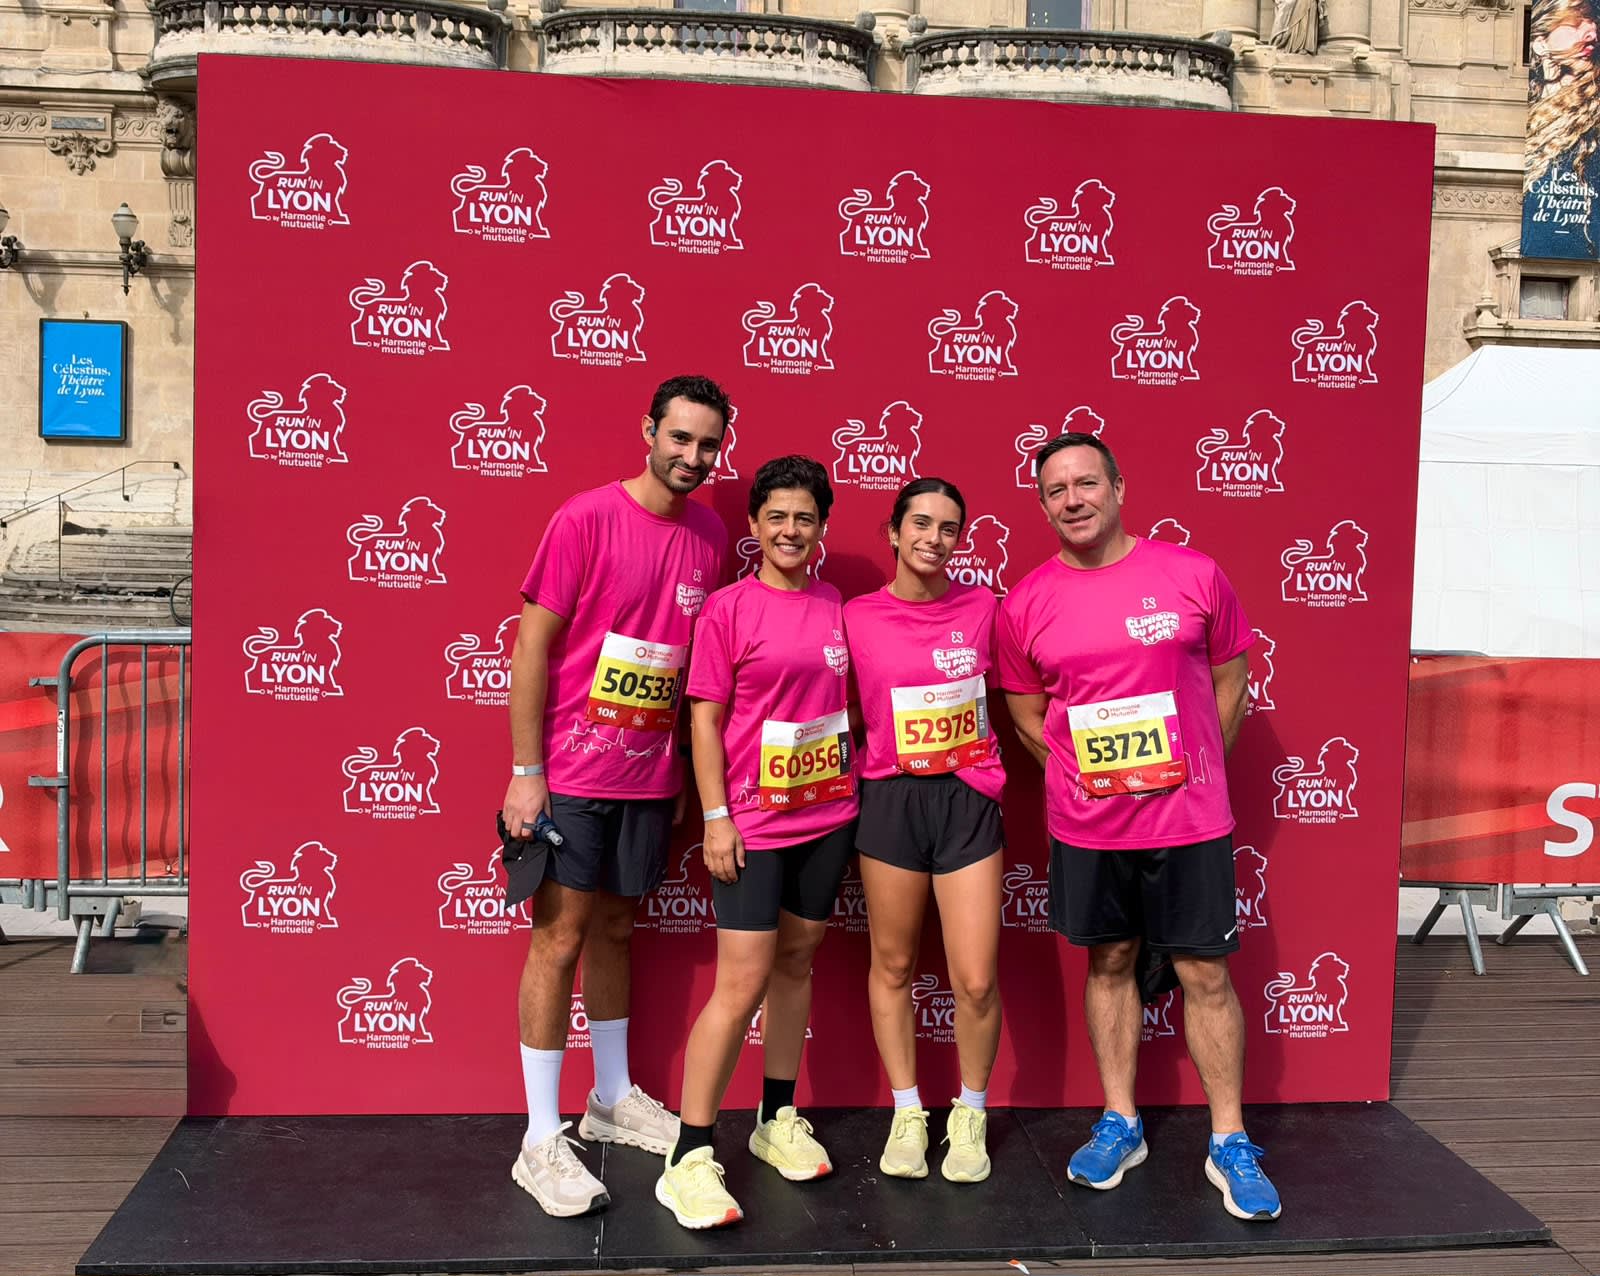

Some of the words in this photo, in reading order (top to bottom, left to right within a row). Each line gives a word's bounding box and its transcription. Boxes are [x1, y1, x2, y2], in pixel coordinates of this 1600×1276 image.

[1553, 168, 1577, 182] Les
[1529, 180, 1598, 198] Célestins,
[268, 189, 331, 212] LYON
[280, 211, 326, 221] Harmonie
[469, 202, 532, 226] LYON
[1533, 208, 1551, 222] de
[1553, 208, 1591, 225] Lyon.
[281, 220, 324, 229] mutuelle
[482, 225, 527, 235] Harmonie
[666, 215, 726, 237] LYON
[483, 234, 525, 243] mutuelle
[678, 237, 721, 247] Harmonie
[855, 225, 914, 247] LYON
[1040, 233, 1098, 254] LYON
[1223, 240, 1280, 259] LYON
[678, 246, 720, 254] mutuelle
[867, 247, 909, 256] Harmonie
[867, 255, 907, 264] mutuelle
[1051, 254, 1093, 263] Harmonie
[1234, 260, 1274, 268] Harmonie
[1052, 262, 1091, 270] mutuelle
[368, 315, 431, 338] LYON
[381, 338, 426, 347] Harmonie
[568, 328, 628, 349] LYON
[381, 346, 425, 355] mutuelle
[580, 349, 624, 358] Harmonie
[759, 337, 817, 358] LYON
[72, 354, 92, 365] Les
[944, 344, 1002, 364] LYON
[1126, 350, 1184, 369] LYON
[580, 358, 622, 366] mutuelle
[770, 358, 813, 367] Harmonie
[1307, 354, 1362, 372] LYON
[53, 363, 111, 376] Célestins,
[771, 366, 811, 374] mutuelle
[955, 365, 996, 373] Harmonie
[57, 386, 71, 395] de
[74, 386, 105, 398] Lyon.
[266, 428, 329, 450] LYON
[278, 450, 324, 460] Harmonie
[468, 439, 530, 461] LYON
[279, 458, 322, 468] mutuelle
[480, 461, 525, 470] Harmonie
[848, 454, 906, 474] LYON
[481, 469, 523, 477] mutuelle
[1211, 463, 1268, 481] LYON
[365, 551, 428, 572] LYON
[378, 572, 423, 581] Harmonie
[1296, 573, 1352, 591] LYON
[378, 580, 421, 589] mutuelle
[1132, 628, 1146, 636] DU
[1148, 620, 1177, 634] PARC
[1143, 627, 1171, 643] LYON
[937, 660, 950, 669] DU
[948, 664, 970, 676] LYON
[262, 663, 325, 684] LYON
[274, 685, 320, 693] Harmonie
[601, 667, 674, 701] 50533
[275, 693, 318, 701] mutuelle
[597, 707, 618, 719] 10K
[905, 710, 976, 745] 52978
[1086, 728, 1163, 764] 53721
[769, 744, 840, 778] 60956
[909, 759, 930, 769] 10K
[1093, 778, 1112, 788] 10K
[360, 783, 422, 802] LYON
[1288, 789, 1343, 808] LYON
[770, 794, 790, 804] 10K
[1544, 782, 1600, 858] S
[258, 897, 320, 916] LYON
[648, 898, 706, 916] LYON
[660, 918, 702, 926] Harmonie
[467, 926, 509, 934] mutuelle
[1279, 1004, 1333, 1023] LYON
[354, 1013, 415, 1032] LYON
[1290, 1030, 1327, 1038] mutuelle
[367, 1041, 408, 1049] mutuelle
